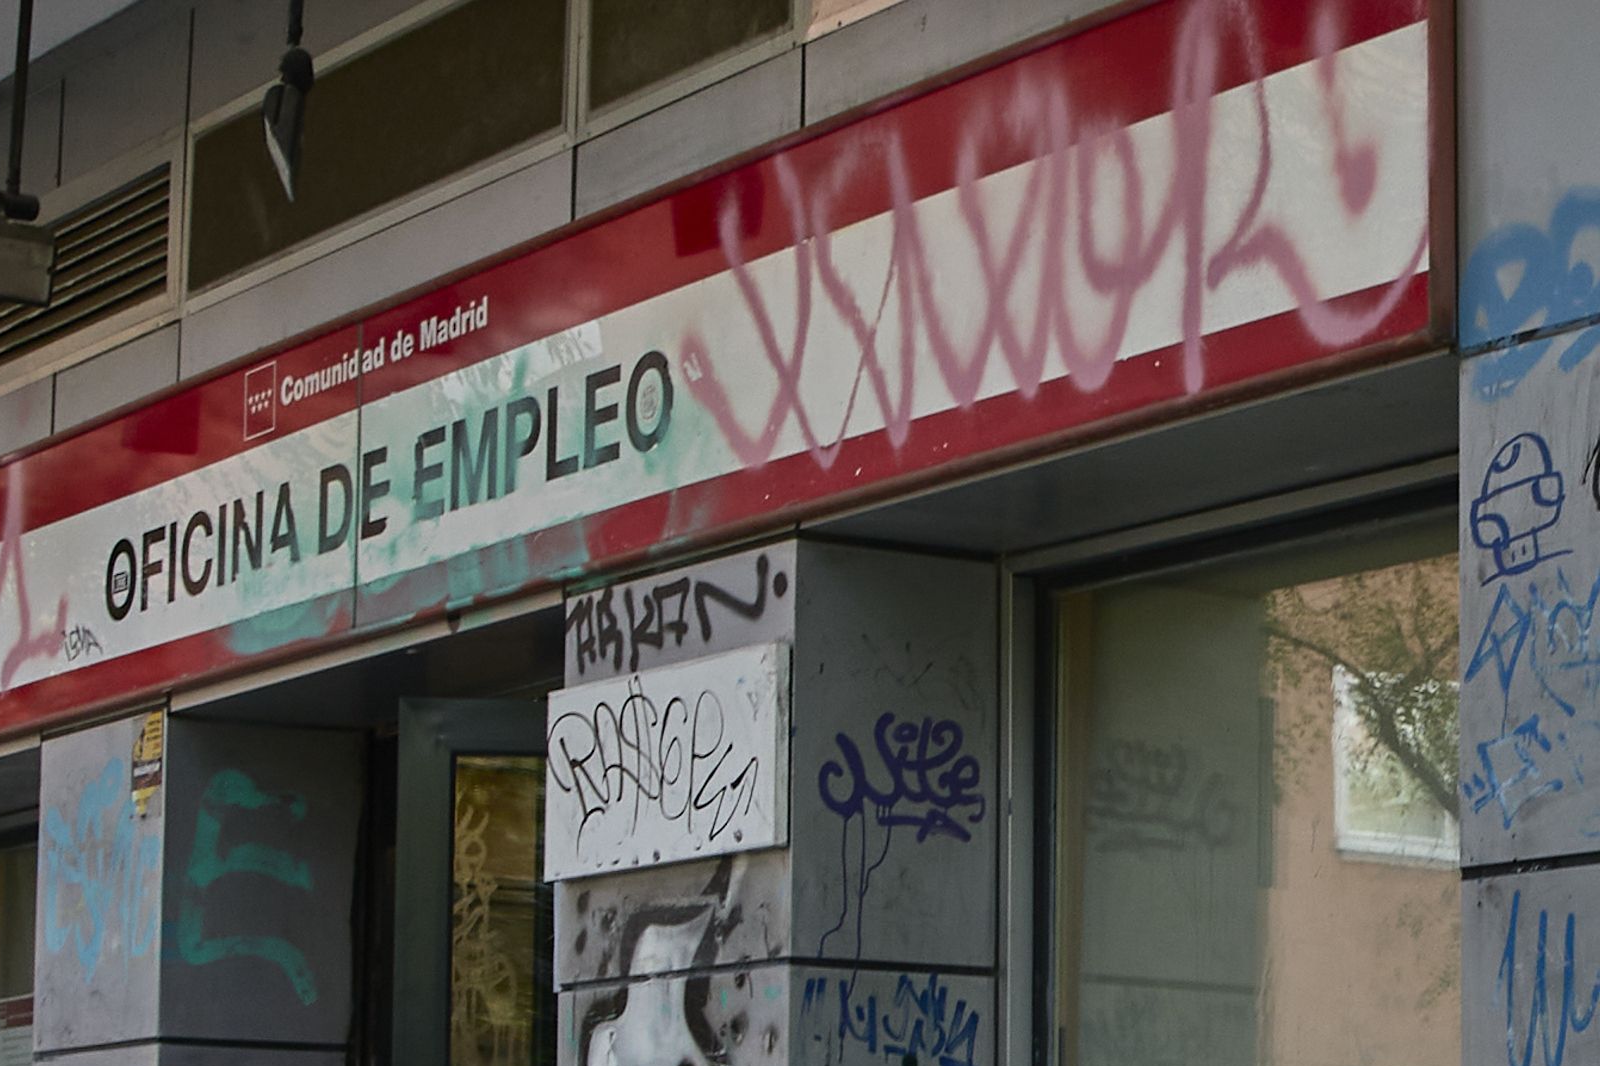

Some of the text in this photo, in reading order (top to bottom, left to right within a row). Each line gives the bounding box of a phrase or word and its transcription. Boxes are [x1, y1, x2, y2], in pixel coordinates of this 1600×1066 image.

[280, 295, 488, 406] Comunidad de Madrid
[106, 482, 299, 621] OFICINA
[318, 446, 390, 555] DE
[414, 349, 673, 520] EMPLEO
